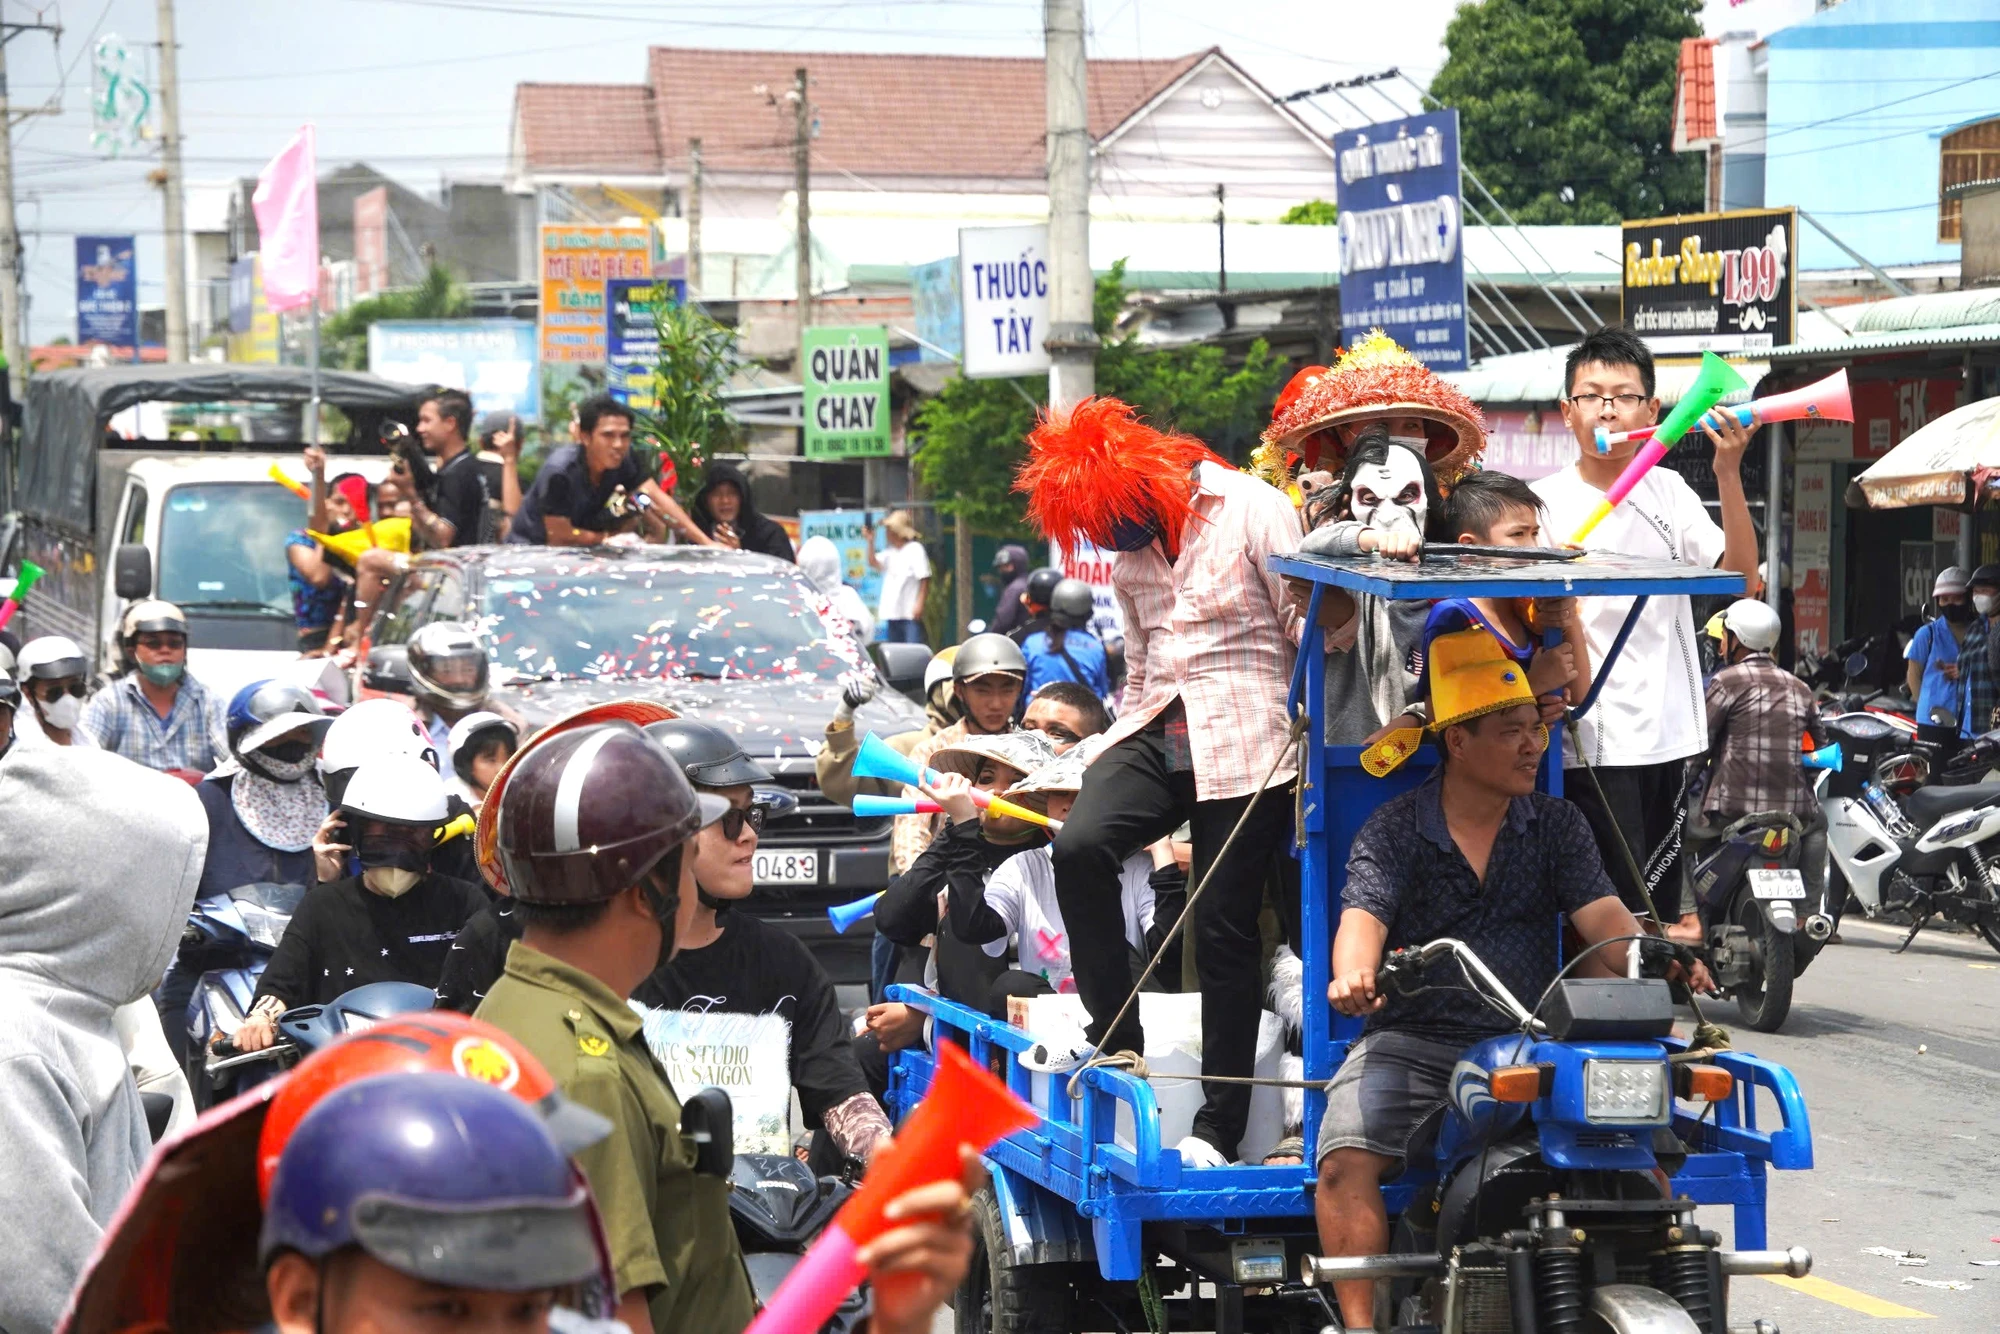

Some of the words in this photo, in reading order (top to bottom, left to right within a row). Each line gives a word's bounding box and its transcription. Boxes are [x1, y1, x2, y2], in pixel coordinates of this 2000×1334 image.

[973, 246, 1048, 300] THUỐC
[1680, 234, 1725, 296] Shop
[1723, 246, 1781, 307] L99
[993, 308, 1033, 354] TÂY
[811, 336, 880, 386] QUÁN
[815, 394, 878, 431] CHAY
[1899, 379, 1929, 438] 5K
[685, 1045, 749, 1065] STUDIO
[691, 1064, 752, 1086] SAIGON
